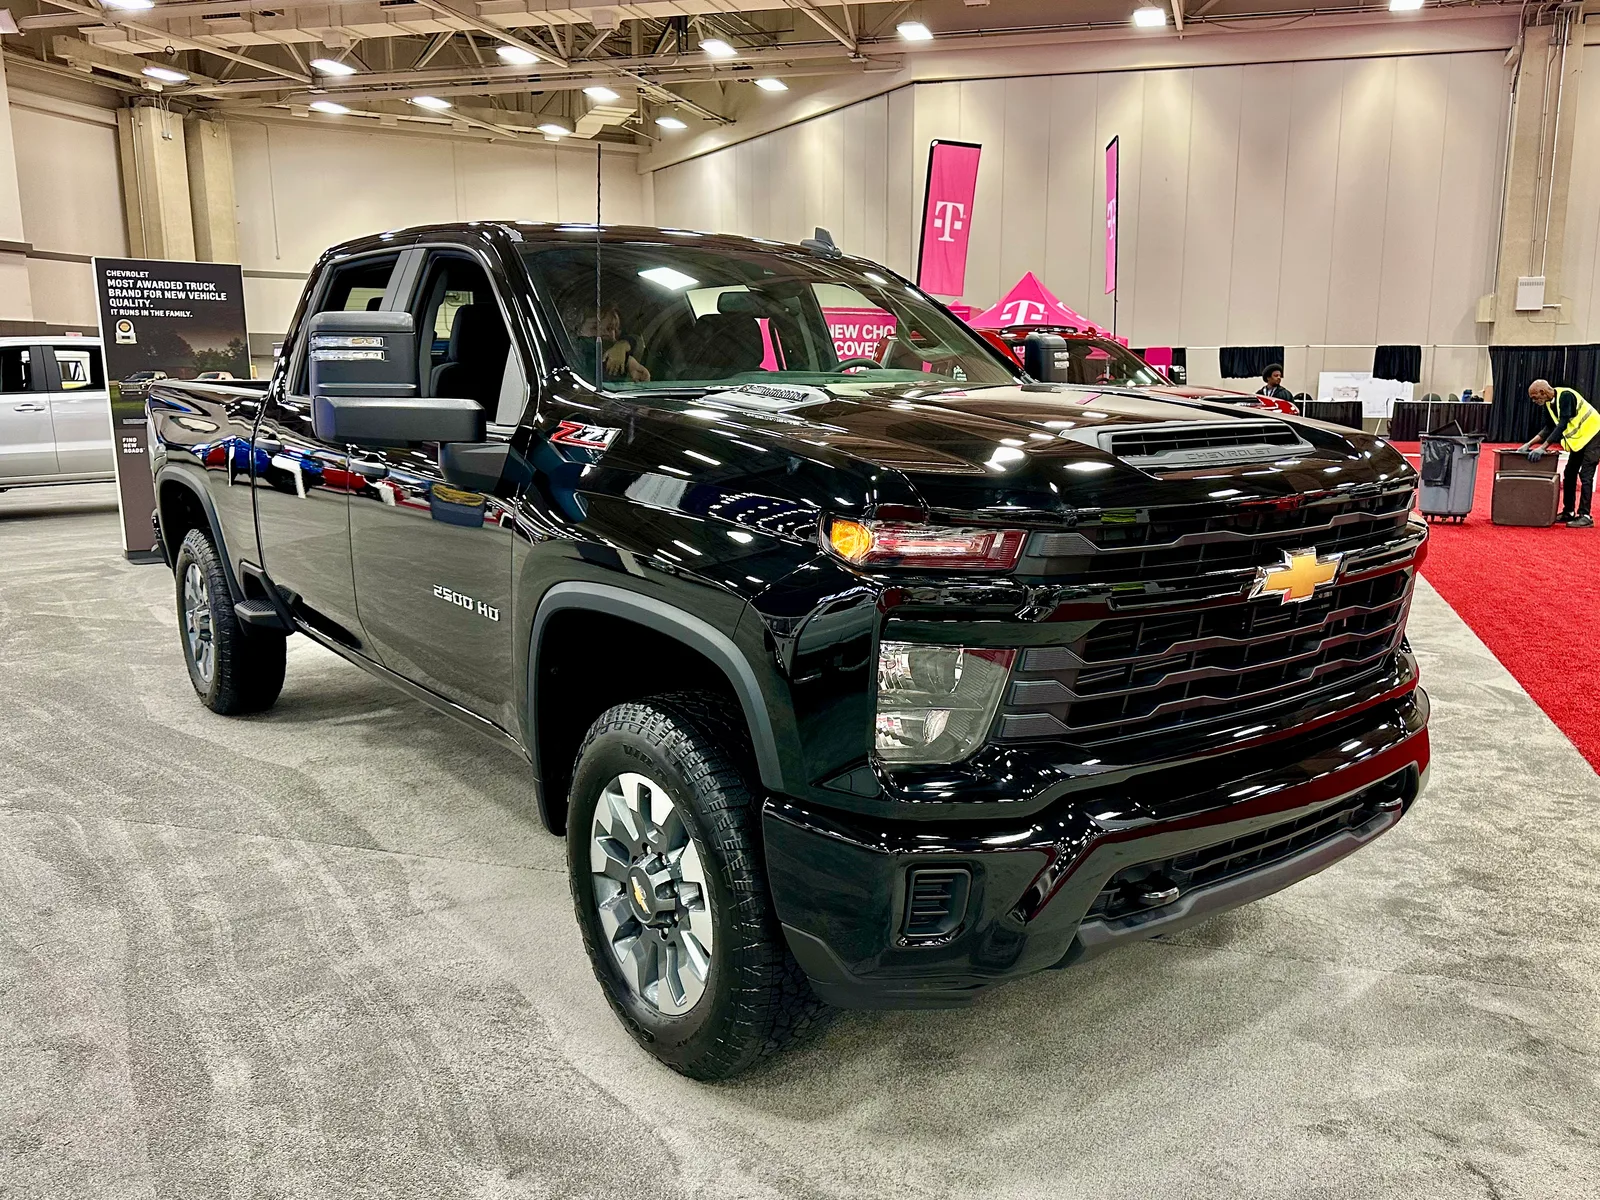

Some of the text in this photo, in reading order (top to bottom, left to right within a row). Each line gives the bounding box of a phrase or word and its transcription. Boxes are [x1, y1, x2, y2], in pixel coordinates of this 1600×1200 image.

[106, 270, 149, 278] CHEVROLET
[107, 278, 216, 291] MOST AWARDED TRUCK
[108, 289, 227, 301] BRAND FOR NEW VEHICLE
[109, 299, 154, 308] QUALITY.
[110, 308, 118, 316] IT
[119, 309, 140, 317] RUNS
[165, 310, 193, 318] FAMILY.
[548, 420, 622, 452] Z71
[1186, 448, 1271, 460] CHEVROLET
[433, 584, 500, 622] 2500 HD
